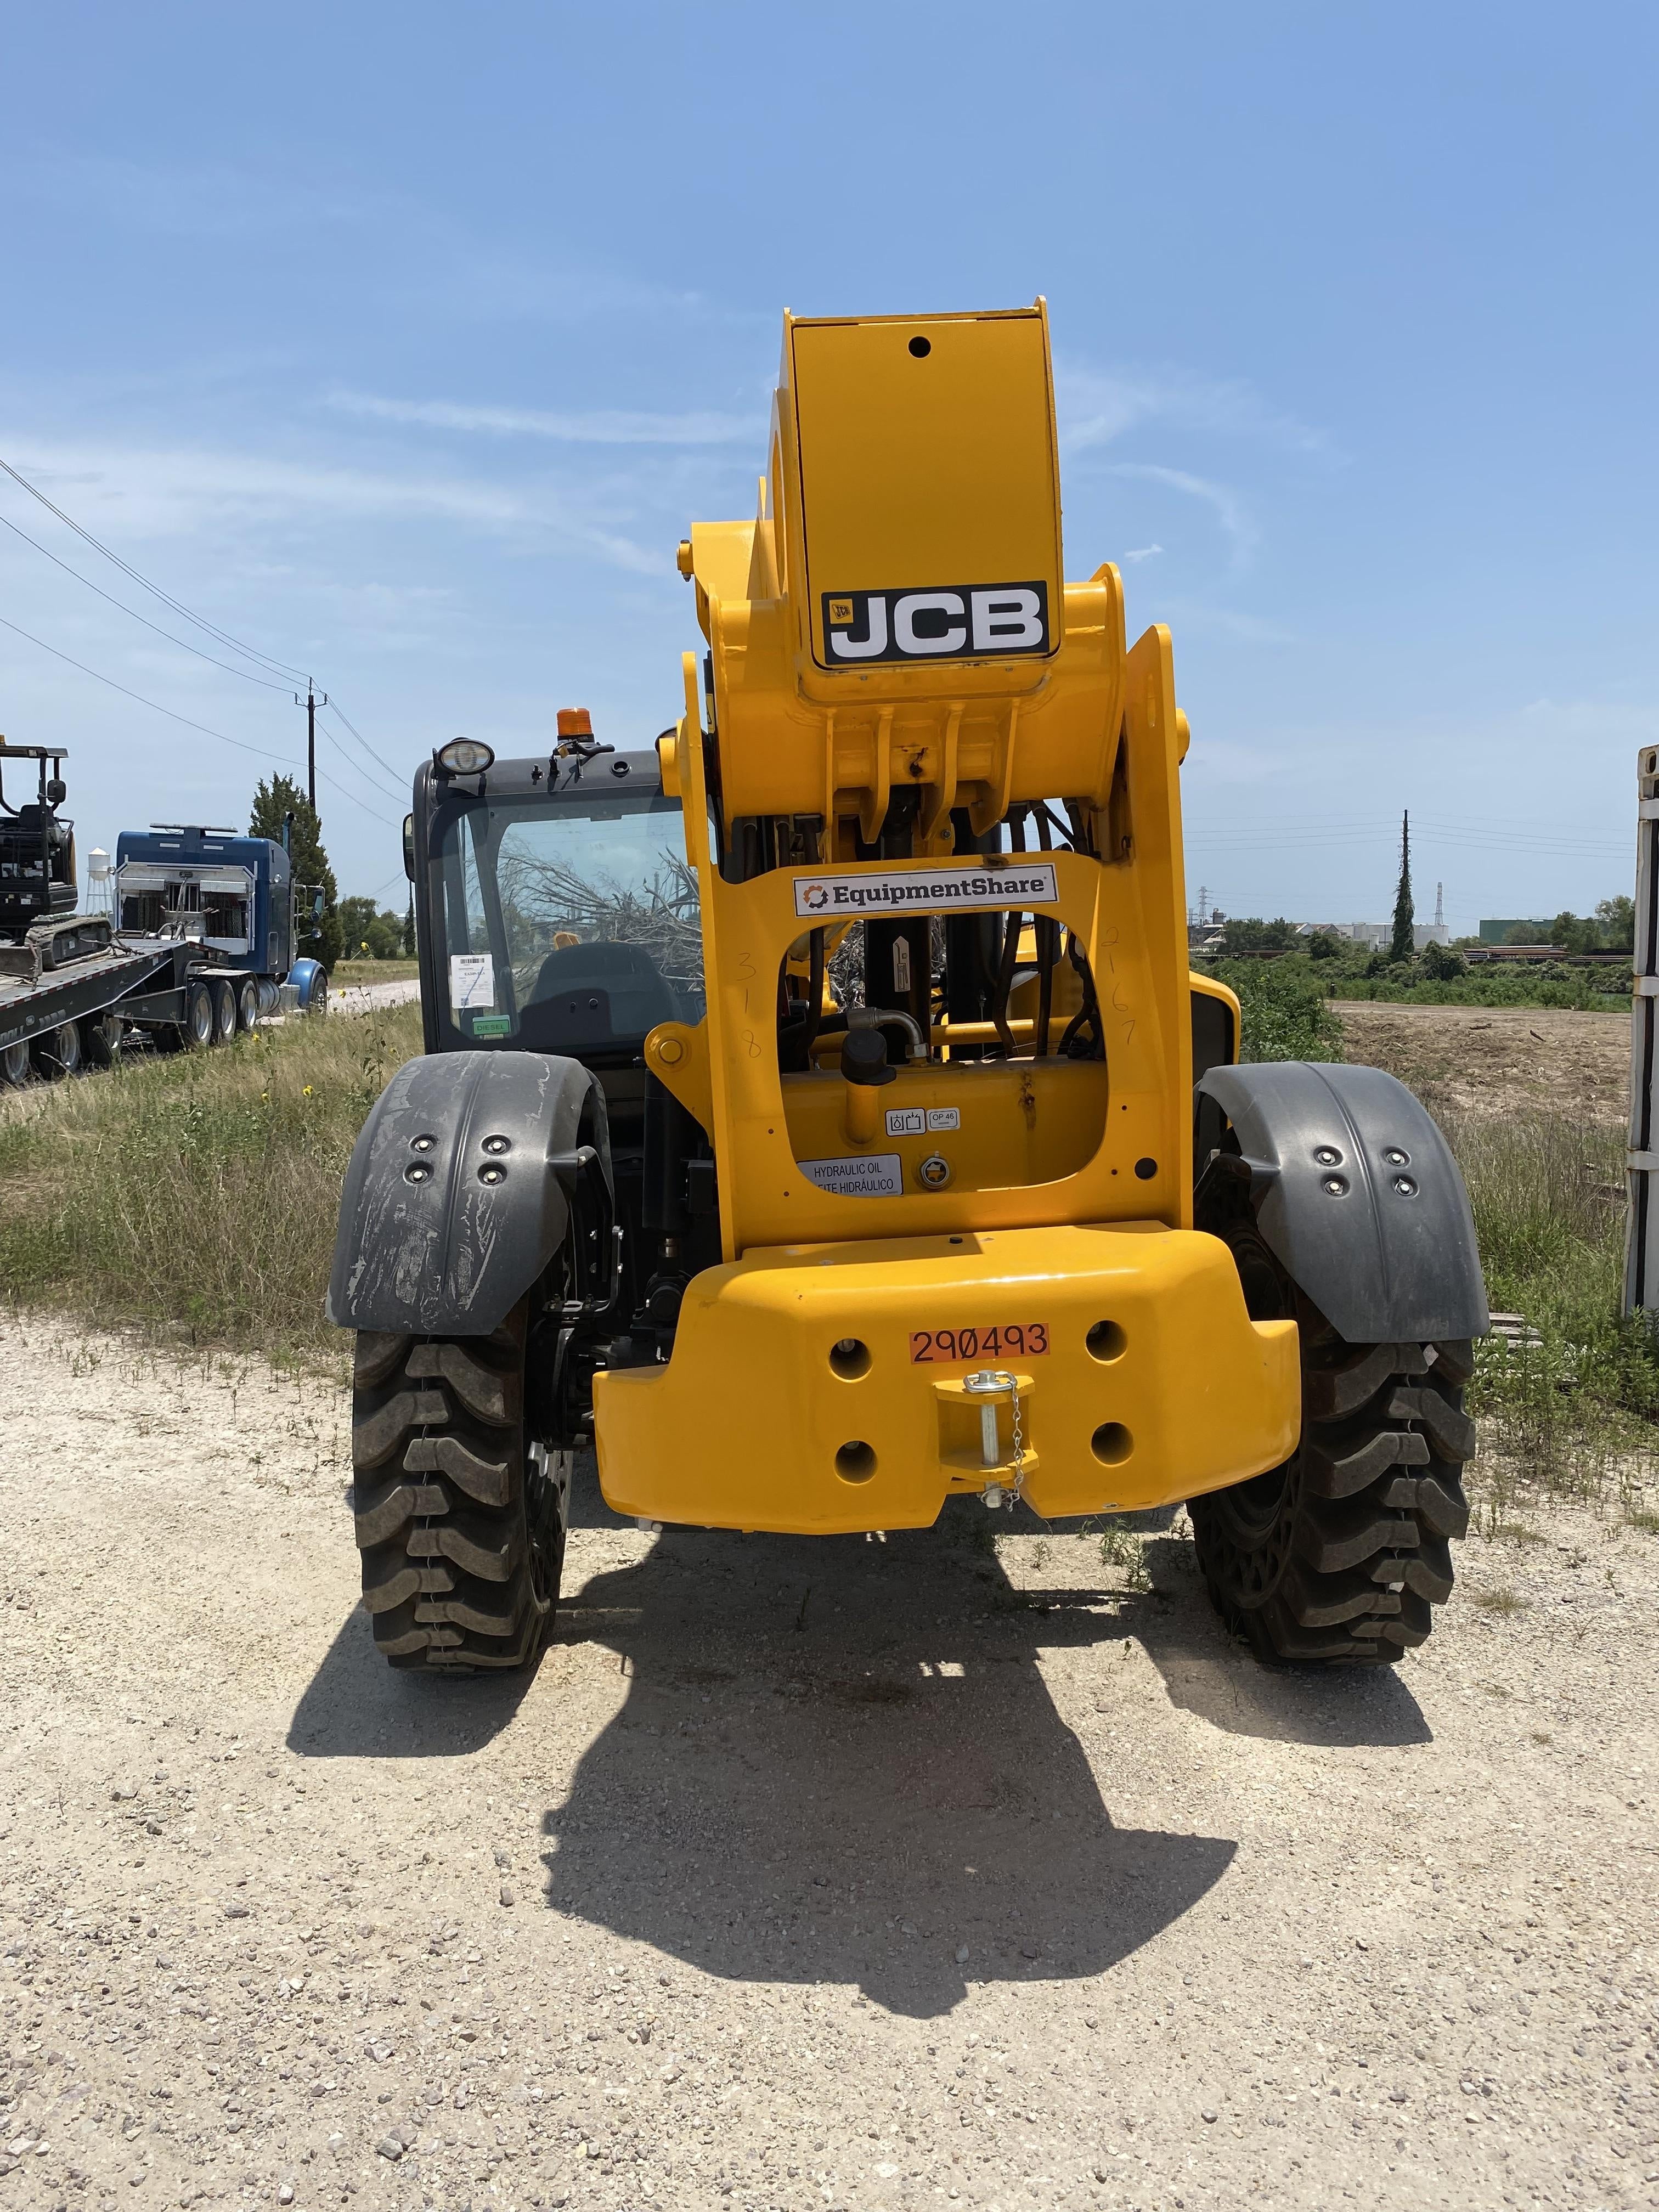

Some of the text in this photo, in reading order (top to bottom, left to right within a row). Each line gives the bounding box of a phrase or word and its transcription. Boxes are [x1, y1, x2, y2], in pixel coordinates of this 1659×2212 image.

[831, 589, 1043, 657] JCB
[833, 878, 1045, 905] EquipmentShare
[814, 1163, 882, 1178] HYDRAULIC OIL
[839, 1178, 894, 1193] HIDRÁULICO
[913, 1323, 1047, 1362] 290493
